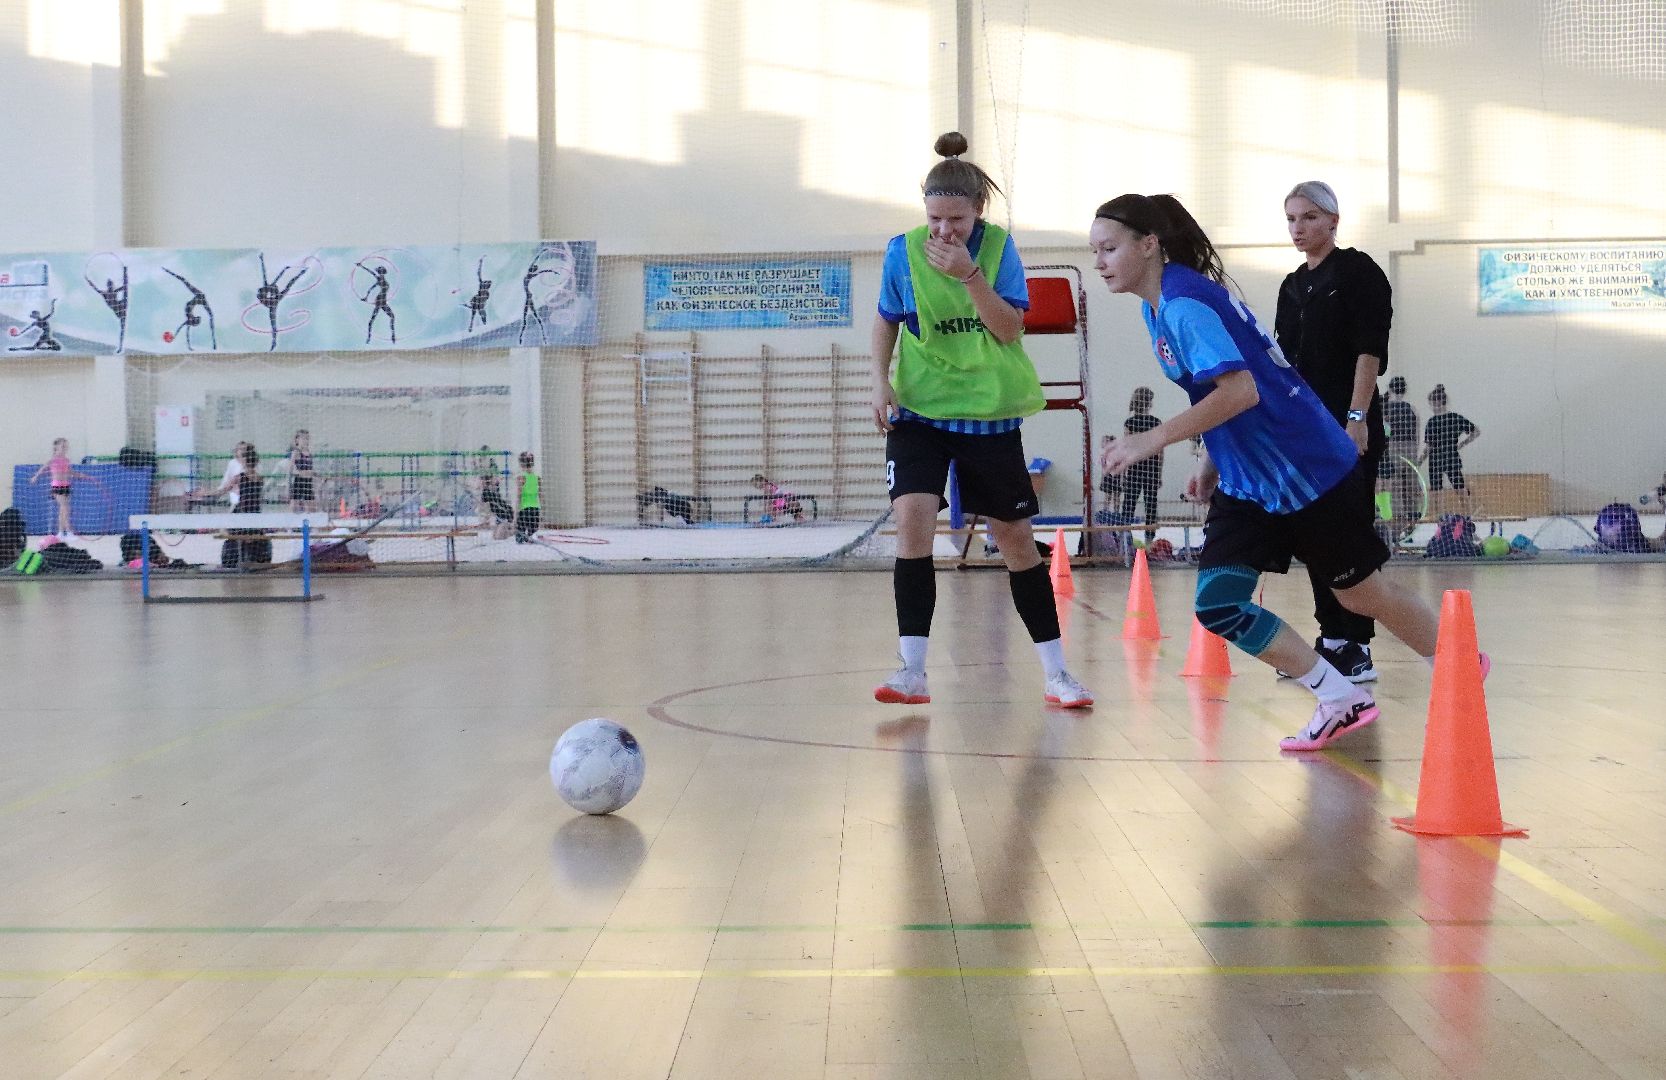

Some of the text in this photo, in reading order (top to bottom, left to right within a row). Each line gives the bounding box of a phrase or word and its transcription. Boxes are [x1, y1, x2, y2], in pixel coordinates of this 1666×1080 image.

[1503, 250, 1664, 262] ФИЗИЧЕСКОМУ ВОСПИТАНИЮ
[1530, 263, 1642, 274] ДОЛЖНО УДЕЛЯТЬСЯ
[673, 268, 821, 281] НИЧТО ТАК НЕ РАЗРУШАЕТ
[1516, 276, 1565, 286] СТОЛЬКО
[1569, 276, 1585, 285] ЖЕ
[1525, 289, 1545, 299] КАК
[1549, 289, 1556, 298] И
[656, 300, 678, 311] КАК
[681, 299, 757, 310] ФИЗИЧЕСКОЕ
